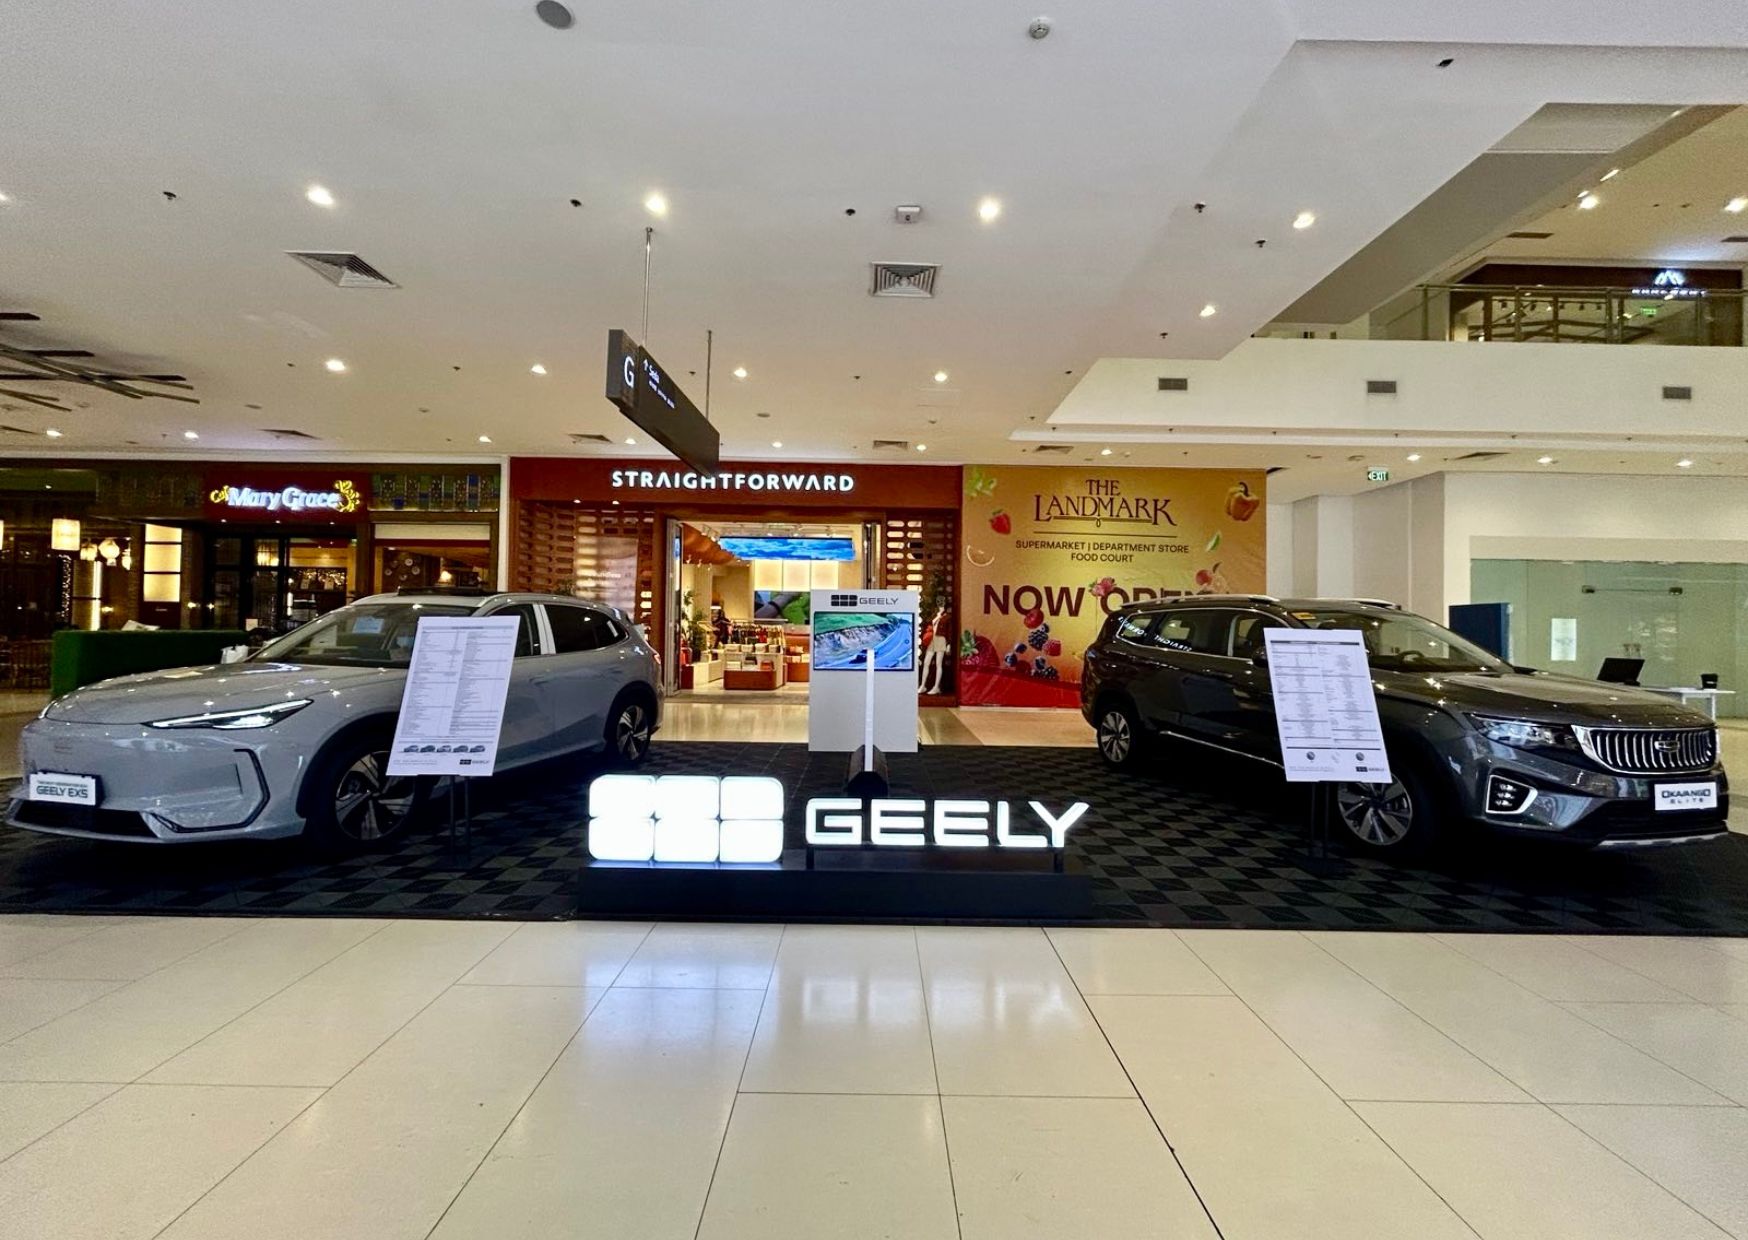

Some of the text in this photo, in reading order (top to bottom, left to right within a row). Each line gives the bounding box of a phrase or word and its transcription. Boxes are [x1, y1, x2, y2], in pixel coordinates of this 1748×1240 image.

[624, 356, 634, 388] G
[612, 471, 854, 491] STRAIGHTFORWARD
[1371, 471, 1386, 480] EXIT
[1086, 479, 1120, 496] THE
[210, 485, 341, 510] Caf Mary Grace
[1034, 494, 1177, 526] LANDMARK
[1015, 539, 1189, 553] SUPERMARKET DEPARTMENT STORE
[1070, 552, 1134, 563] FOOD COURT
[859, 597, 898, 605] GEELY
[983, 584, 1086, 617] NOW
[36, 786, 66, 796] GEELY
[805, 798, 1089, 848] GEELY
